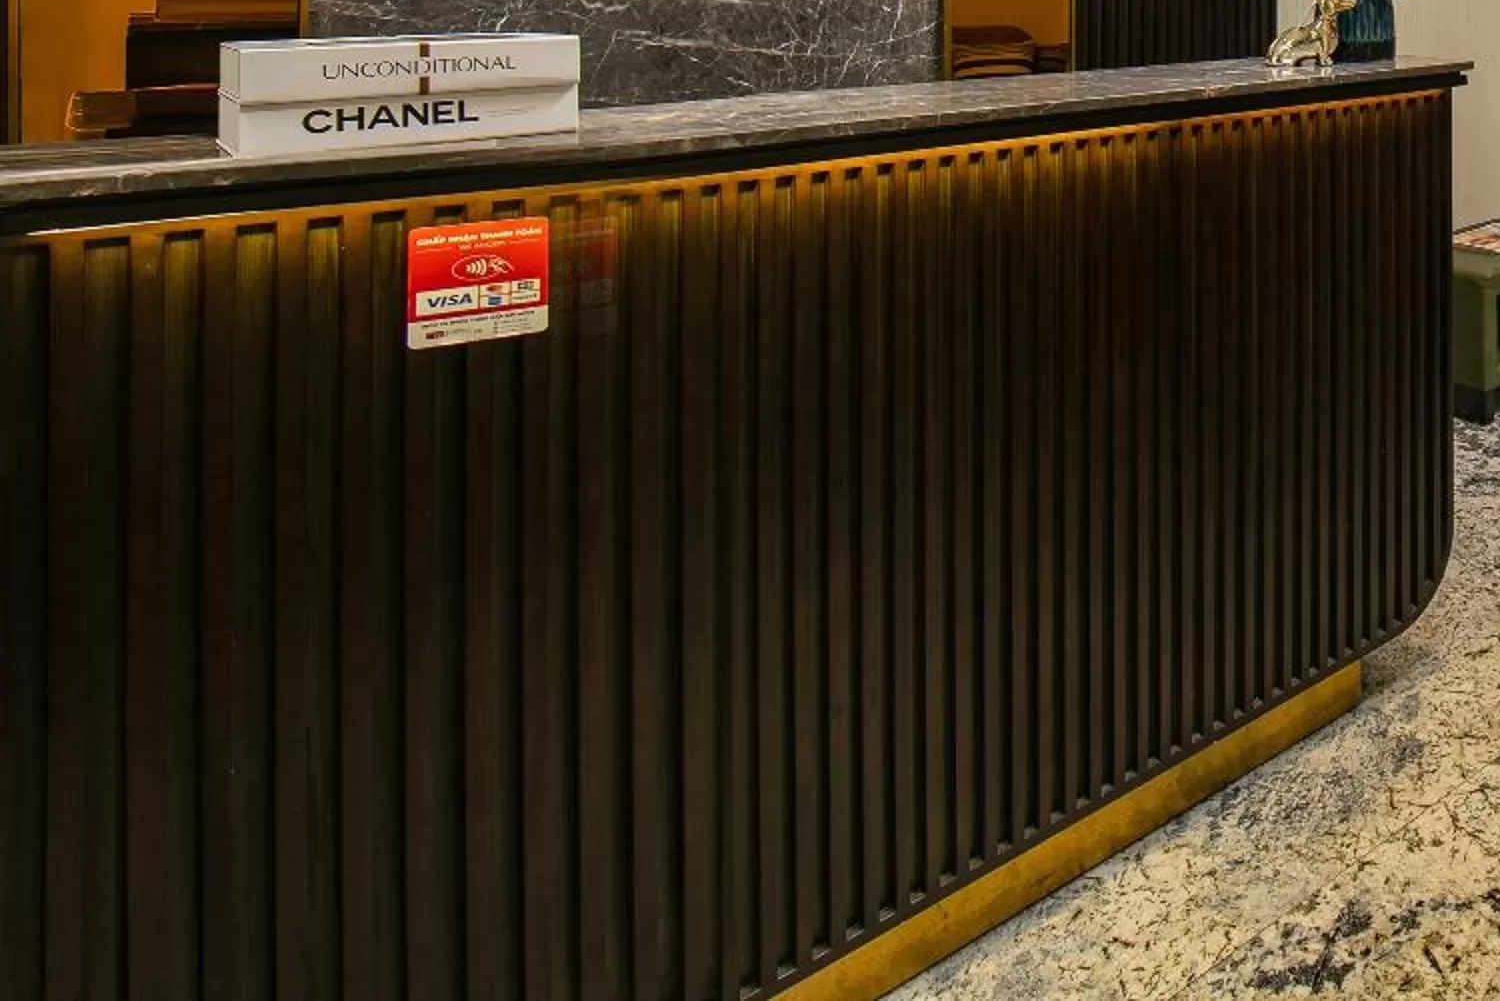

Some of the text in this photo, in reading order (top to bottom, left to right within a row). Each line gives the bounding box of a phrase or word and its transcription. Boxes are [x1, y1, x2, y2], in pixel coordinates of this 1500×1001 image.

[322, 55, 517, 81] UNCONDITIONAL
[302, 99, 480, 134] CHANEL
[427, 293, 472, 308] VISA
